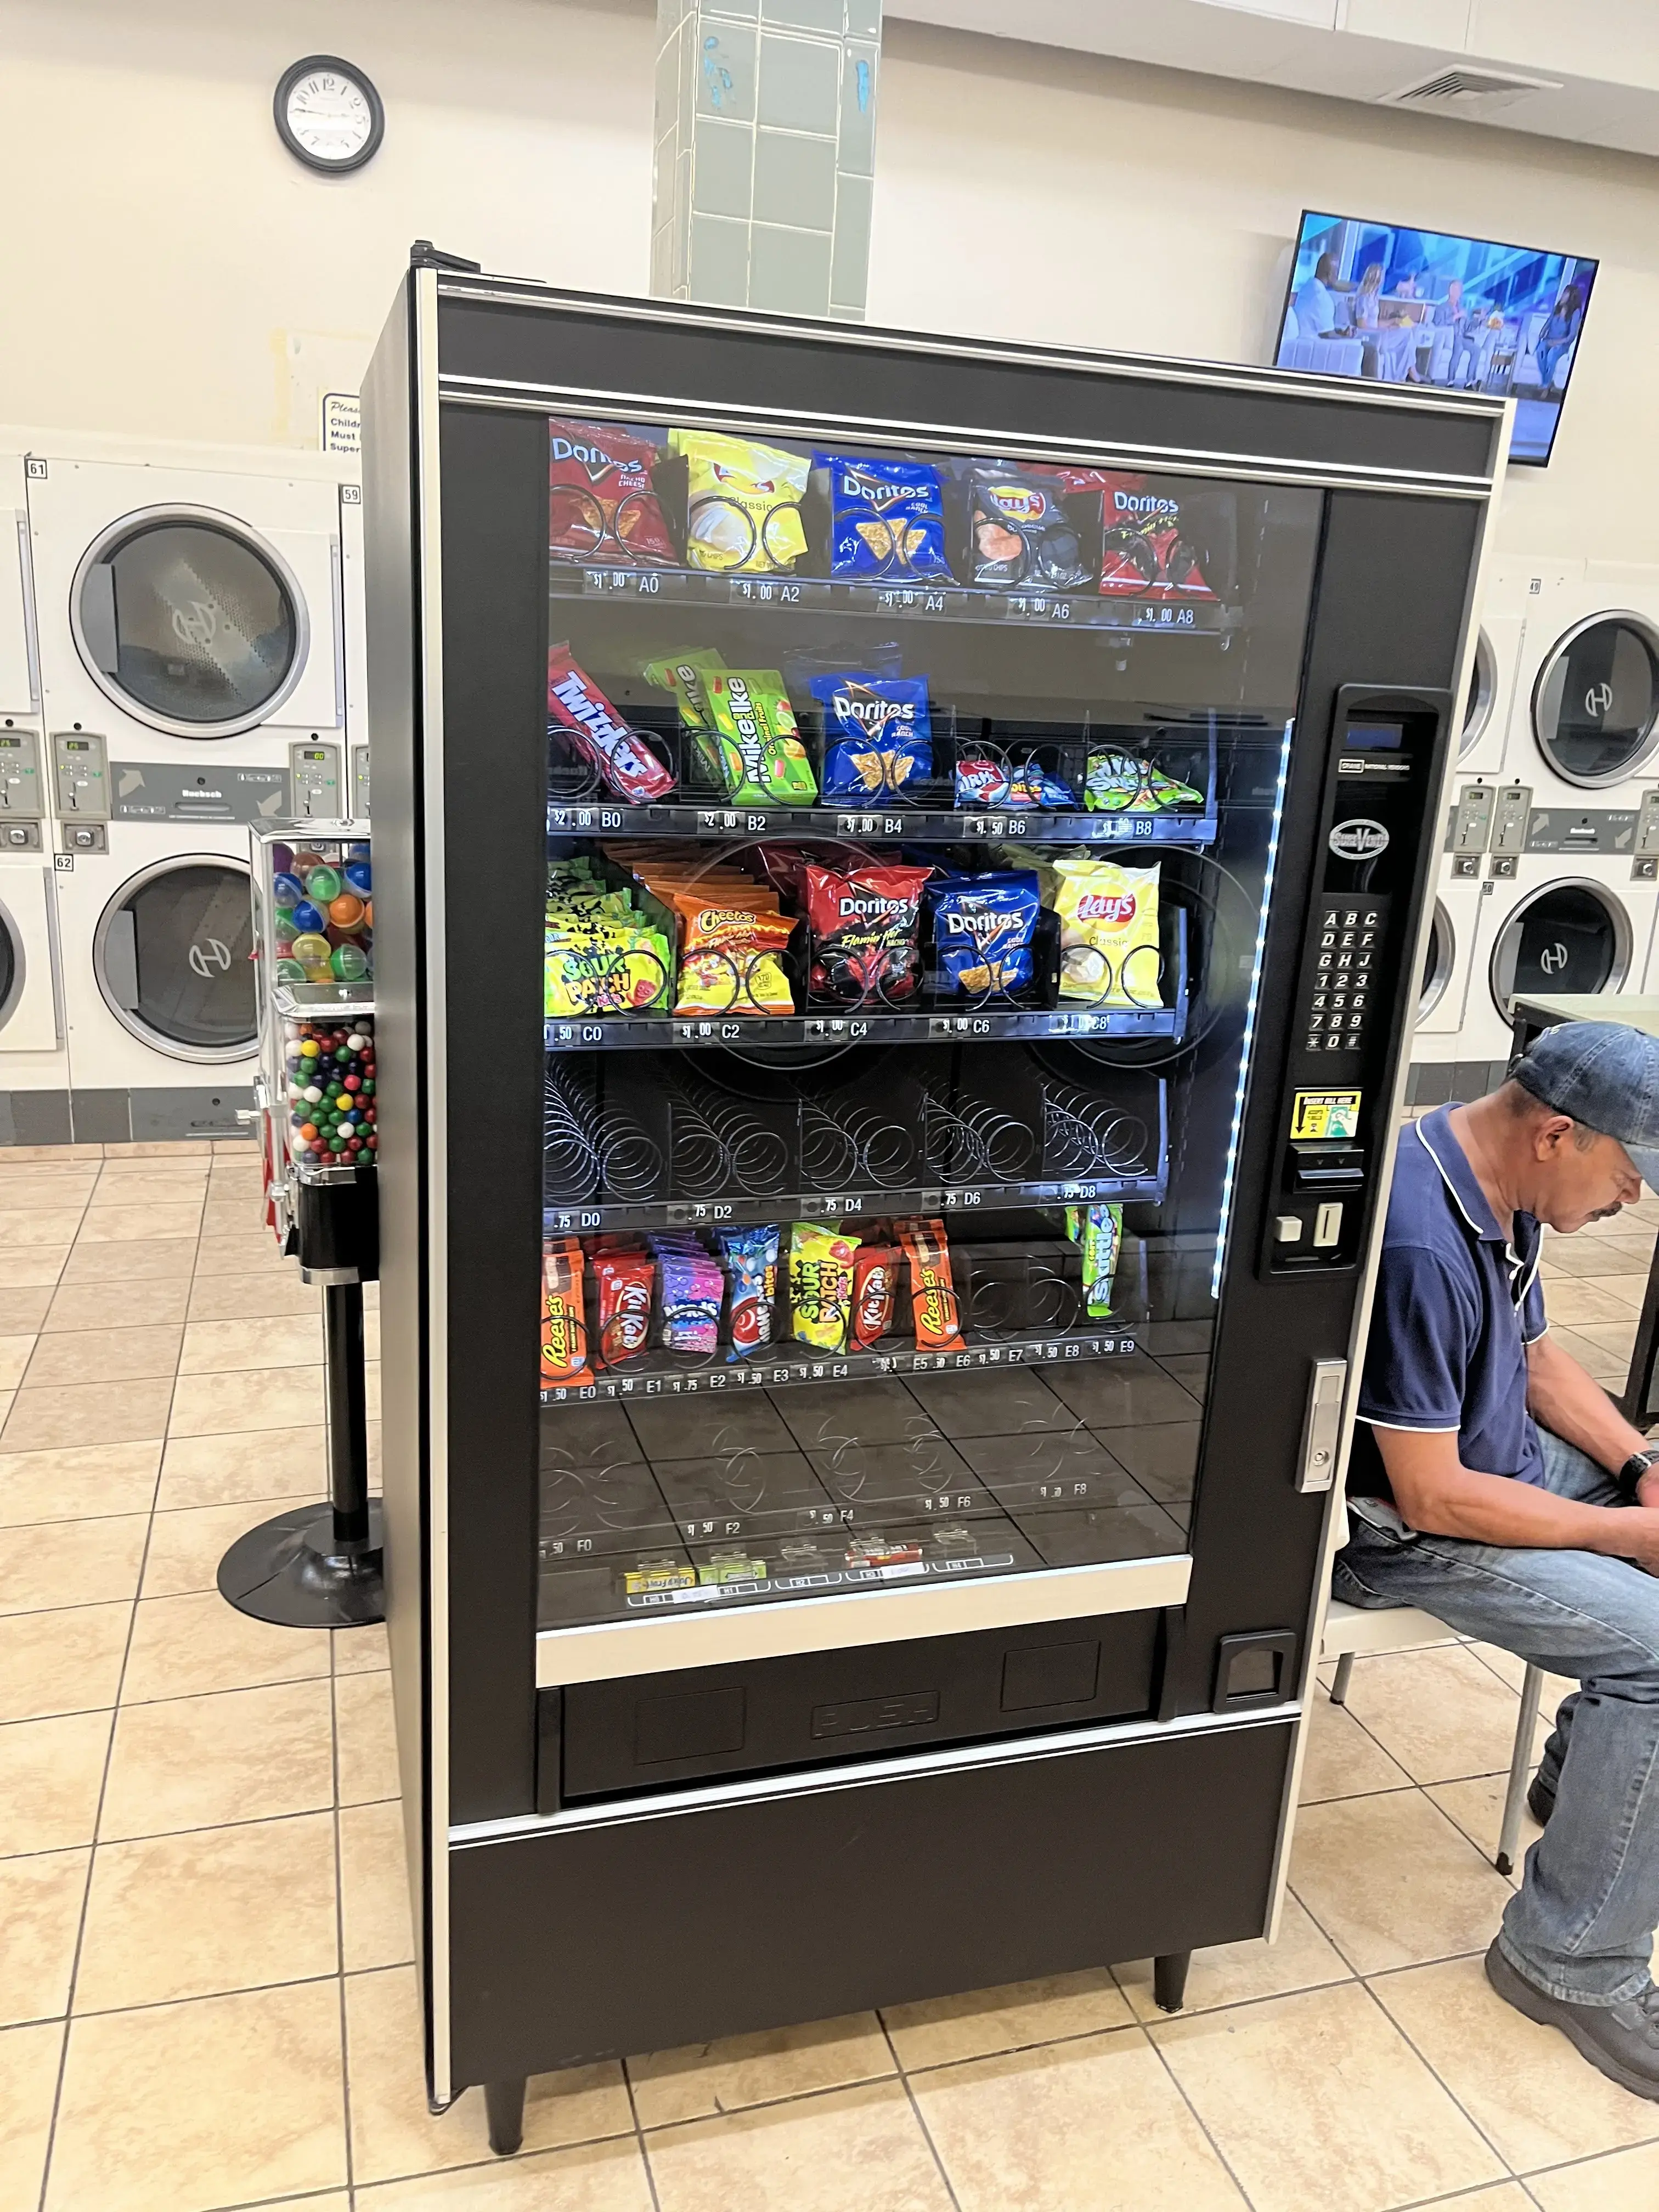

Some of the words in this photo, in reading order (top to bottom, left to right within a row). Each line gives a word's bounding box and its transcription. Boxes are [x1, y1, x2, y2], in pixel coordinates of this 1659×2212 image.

[330, 417, 361, 428] Childr
[331, 431, 356, 440] Must
[330, 443, 361, 453] Super
[30, 463, 44, 475] 61
[843, 475, 929, 500] Doritos
[345, 489, 358, 500] 59
[1114, 492, 1179, 514] Doritos
[781, 585, 800, 602] A2
[925, 595, 944, 611] A4
[1052, 603, 1069, 619] A6
[1177, 609, 1193, 624] A8
[727, 676, 753, 713] Ike
[833, 696, 915, 720] Doritos
[737, 718, 772, 783] Mike
[748, 815, 766, 831] B2
[885, 819, 902, 834] B4
[1008, 820, 1026, 834] B6
[1136, 821, 1152, 835] B8
[57, 857, 71, 868] 62
[839, 897, 909, 917] Doritos
[700, 910, 755, 933] Cheetos
[947, 911, 1024, 934] Doritos
[1324, 913, 1336, 925] A
[1345, 913, 1358, 925] B
[1365, 913, 1378, 925] C
[1322, 933, 1335, 946] D
[1342, 933, 1355, 946] E
[1362, 933, 1374, 946] F
[1319, 954, 1332, 966] G
[1338, 954, 1352, 967] H
[1359, 954, 1370, 966] J
[1320, 975, 1328, 987] 1
[1336, 975, 1348, 987] 2
[1356, 975, 1368, 987] 3
[1314, 995, 1325, 1007] 4
[1333, 995, 1345, 1007] 5
[1353, 995, 1364, 1007] 6
[973, 1019, 990, 1034] C6
[1312, 1016, 1323, 1028] 7
[1330, 1016, 1342, 1028] 8
[1350, 1015, 1362, 1028] 9
[722, 1024, 740, 1039] C2
[850, 1022, 867, 1036] C4
[1328, 1036, 1340, 1048] 0
[964, 1192, 981, 1205] D6
[1080, 1185, 1096, 1199] D8
[845, 1198, 862, 1211] D4
[714, 1205, 732, 1219] D2
[800, 1263, 820, 1319] SOUR
[819, 1261, 839, 1323] PATCH
[920, 1268, 944, 1335] Reese's
[542, 1294, 568, 1368] Reese's
[1065, 1345, 1080, 1357] E8
[1120, 1340, 1135, 1352] E9
[956, 1355, 970, 1367] E6
[1009, 1349, 1023, 1362] E7
[833, 1364, 848, 1377] E4
[913, 1358, 928, 1370] E5
[710, 1375, 726, 1388] E2
[774, 1369, 789, 1382] E3
[646, 1380, 661, 1393] E1
[1074, 1483, 1087, 1494] F8
[957, 1496, 971, 1508] F6
[840, 1509, 854, 1522] F4
[725, 1522, 740, 1534] F2
